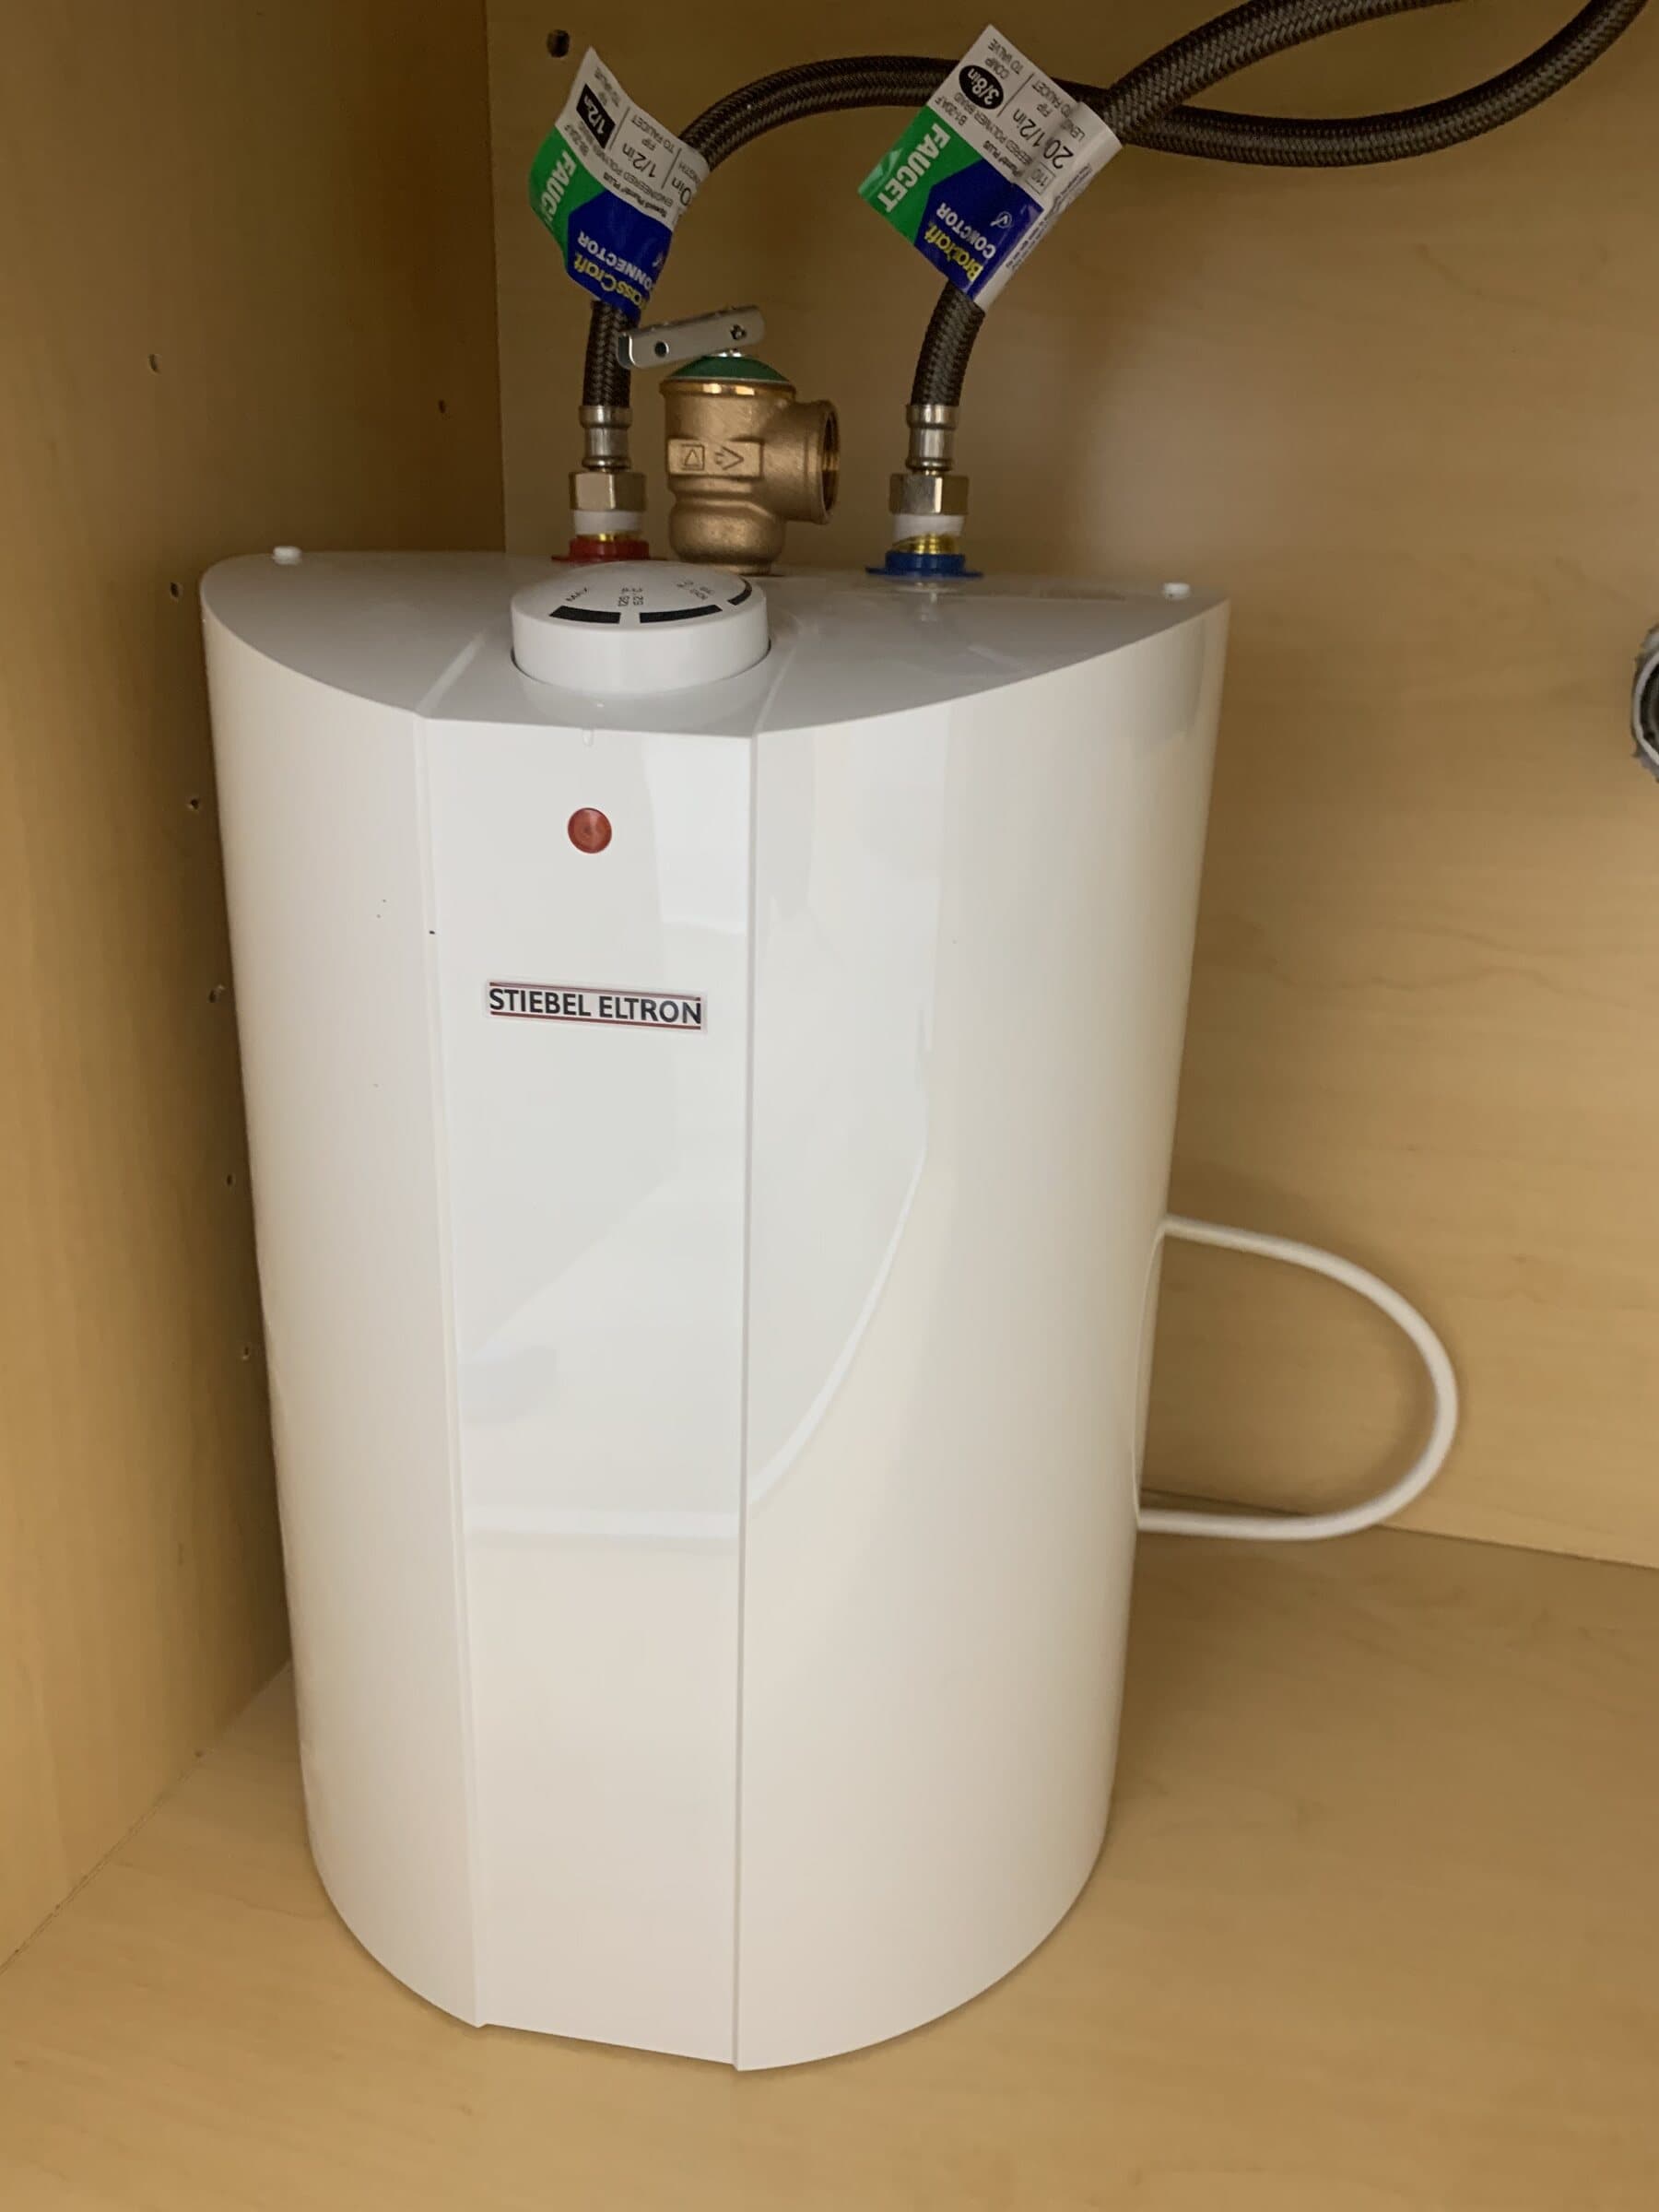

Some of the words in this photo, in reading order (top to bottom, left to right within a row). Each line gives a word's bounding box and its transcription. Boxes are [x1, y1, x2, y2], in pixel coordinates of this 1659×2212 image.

[967, 67, 1000, 105] 3/8in
[984, 57, 1010, 80] COMP
[1009, 59, 1024, 75] TO
[1032, 79, 1061, 109] FAUCET
[583, 95, 606, 135] 1/2in
[1013, 108, 1045, 147] 1/2in
[622, 143, 656, 178] 1/2in
[877, 123, 951, 213] FAUCET
[1043, 138, 1074, 170] 20
[540, 150, 577, 222] FAUC
[577, 230, 653, 290] ONNECTOR
[573, 252, 649, 310] assCraft
[489, 987, 592, 1017] STIEBEL
[598, 995, 700, 1025] ELTRON
